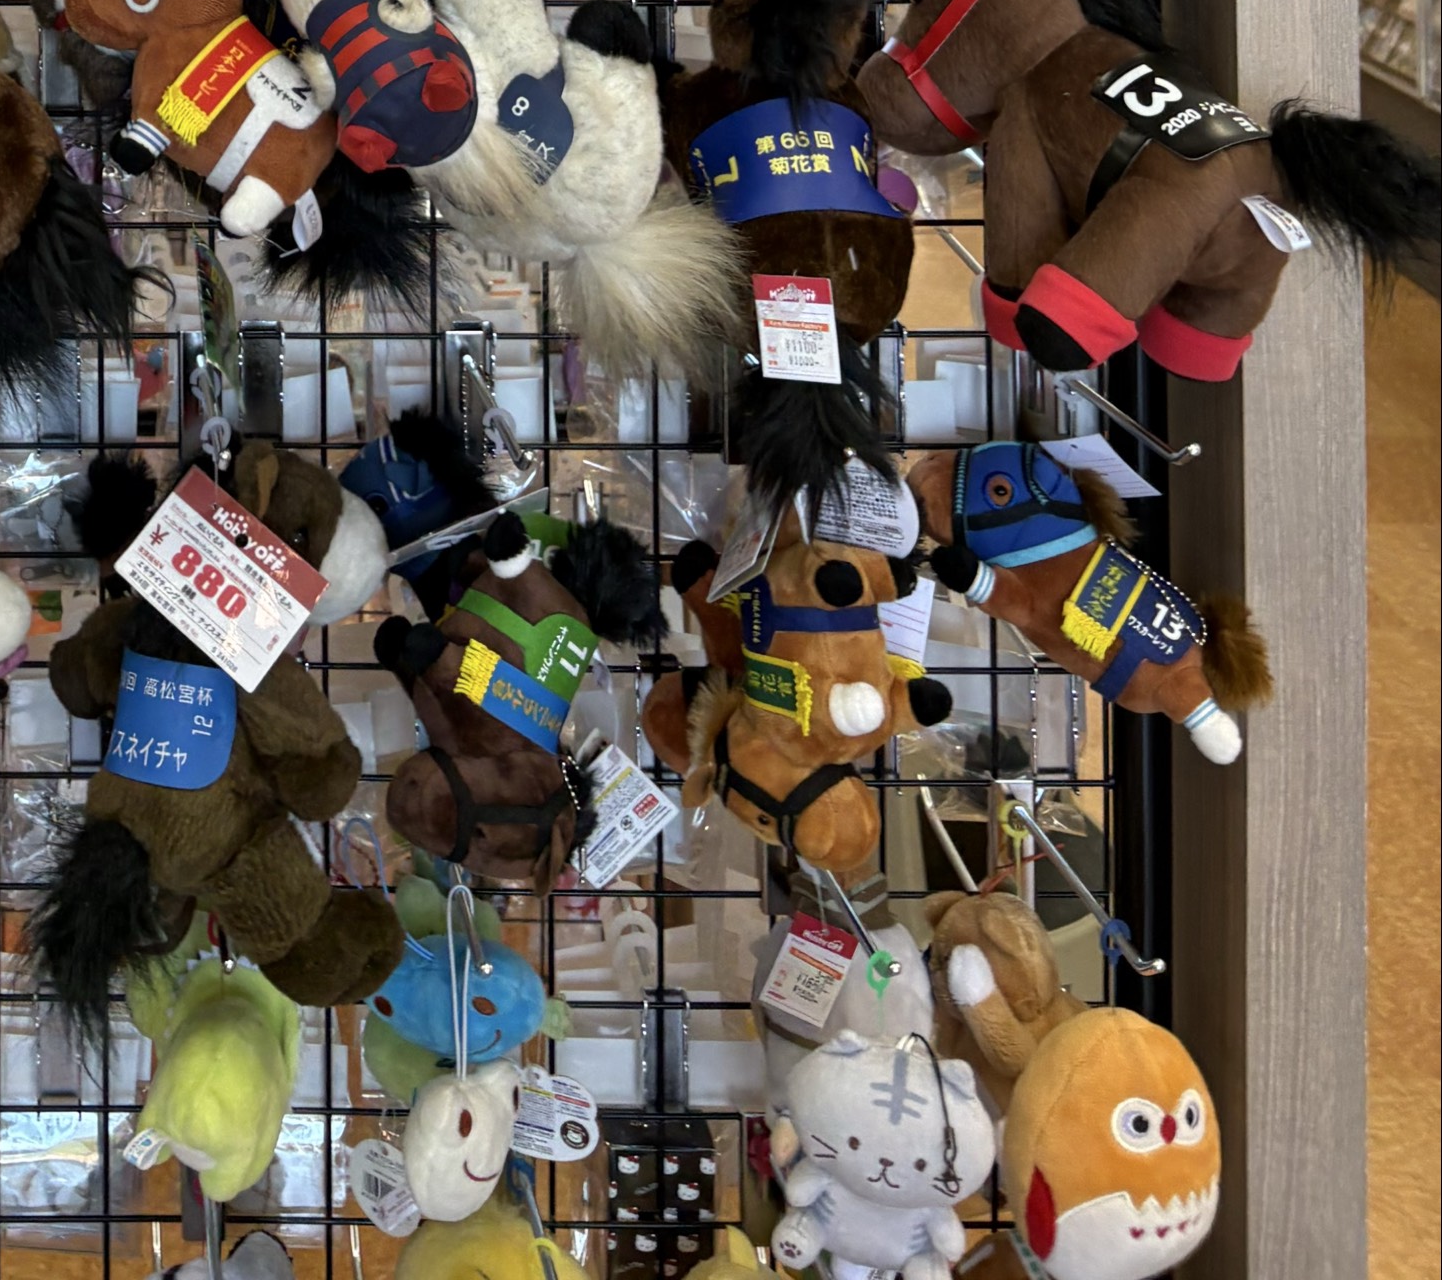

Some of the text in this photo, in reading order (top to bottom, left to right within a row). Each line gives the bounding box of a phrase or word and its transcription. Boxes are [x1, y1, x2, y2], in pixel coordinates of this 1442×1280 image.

[188, 45, 246, 103] 日本ダービー
[1104, 63, 1184, 117] 13
[511, 96, 530, 117] 8
[1161, 108, 1203, 136] 2020
[755, 130, 835, 156] 第66回
[769, 153, 832, 176] 菊花賞
[171, 543, 247, 619] 880
[1151, 602, 1186, 641] 13
[559, 640, 589, 678] 11
[143, 676, 215, 707] 高松宮杯
[191, 714, 214, 737] 12
